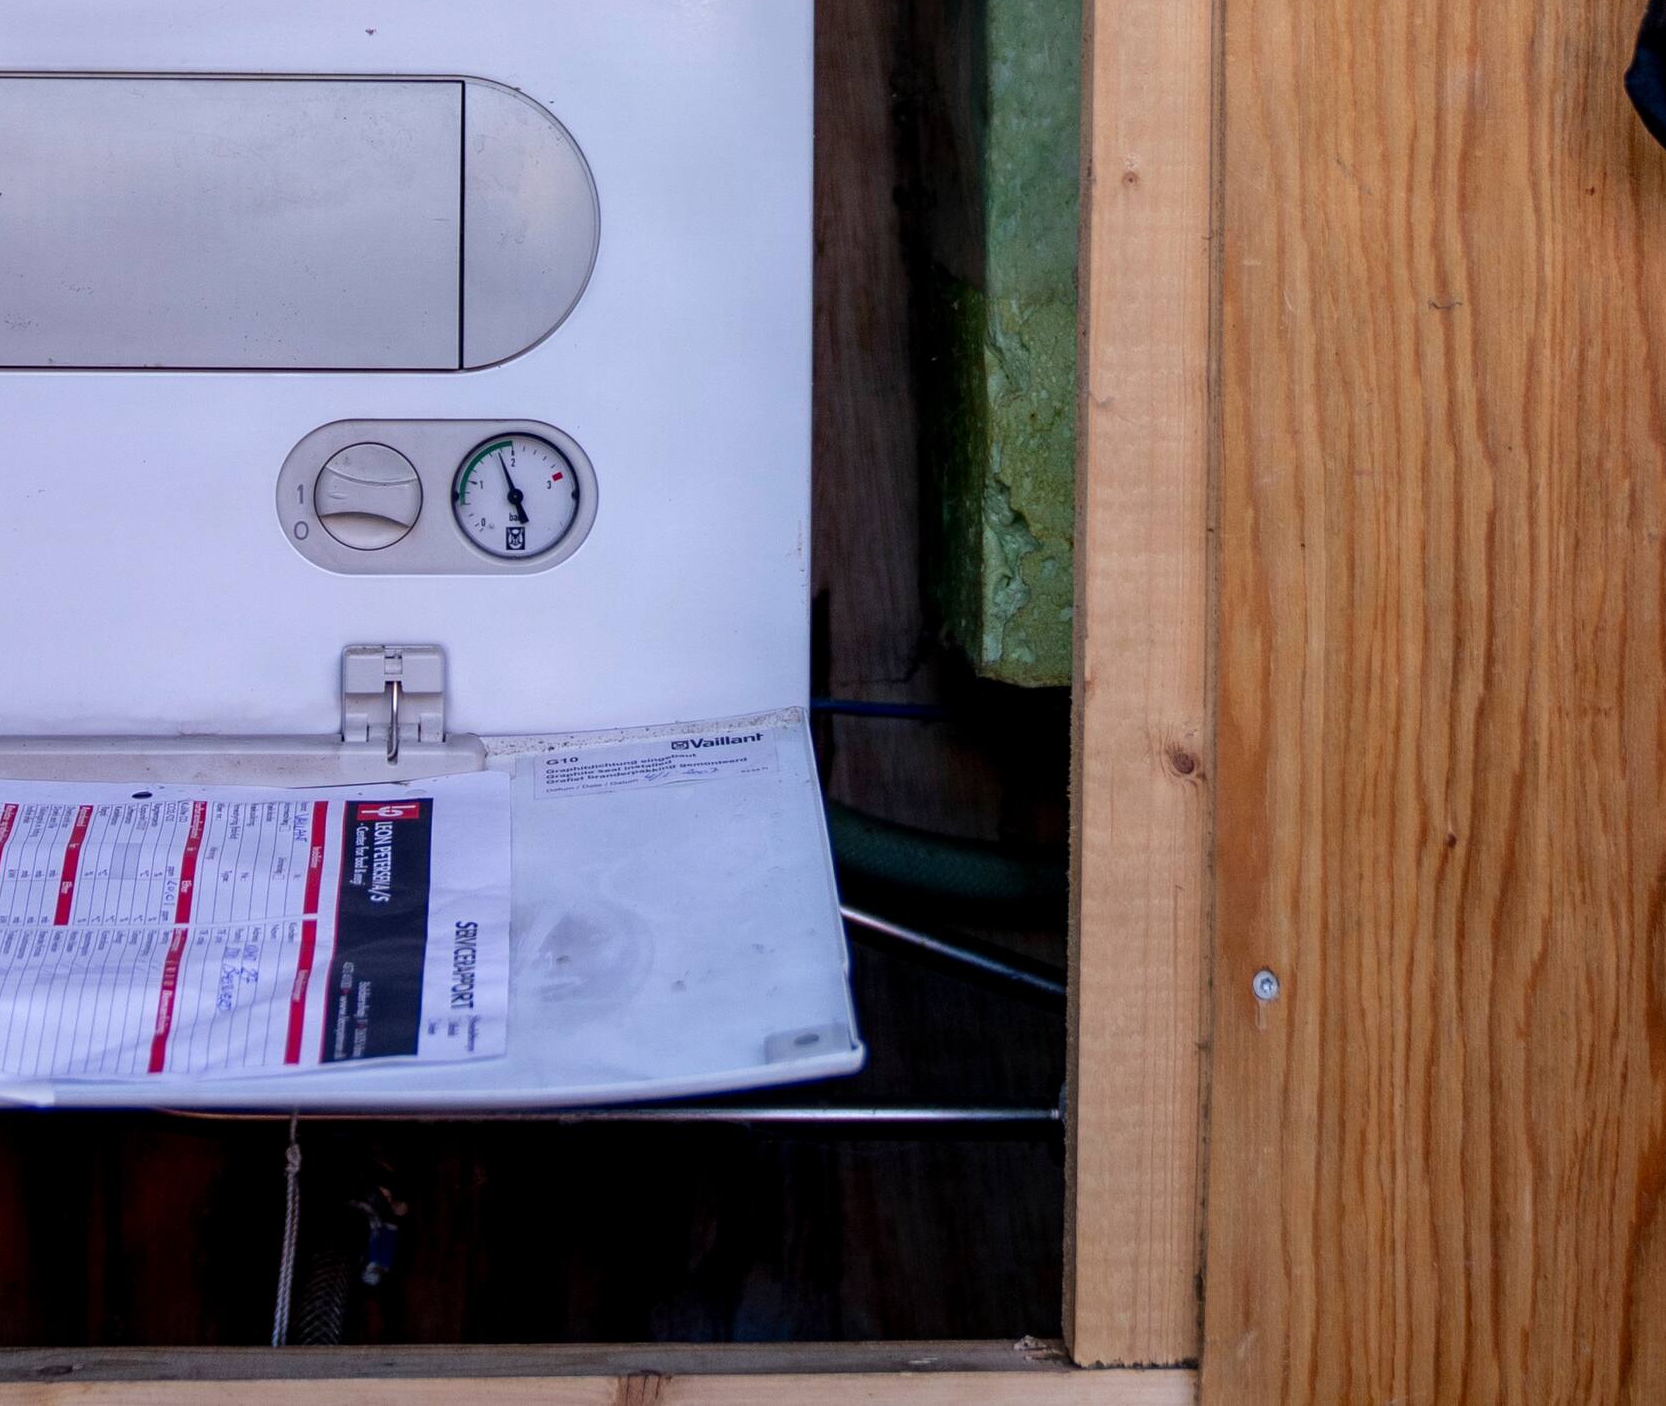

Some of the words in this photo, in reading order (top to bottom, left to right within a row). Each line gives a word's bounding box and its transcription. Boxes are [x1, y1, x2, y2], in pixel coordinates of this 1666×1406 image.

[689, 732, 765, 749] Vaillant
[546, 756, 579, 766] G10
[373, 821, 393, 846] LEON
[450, 920, 479, 1010] SERVICERAPPORT
